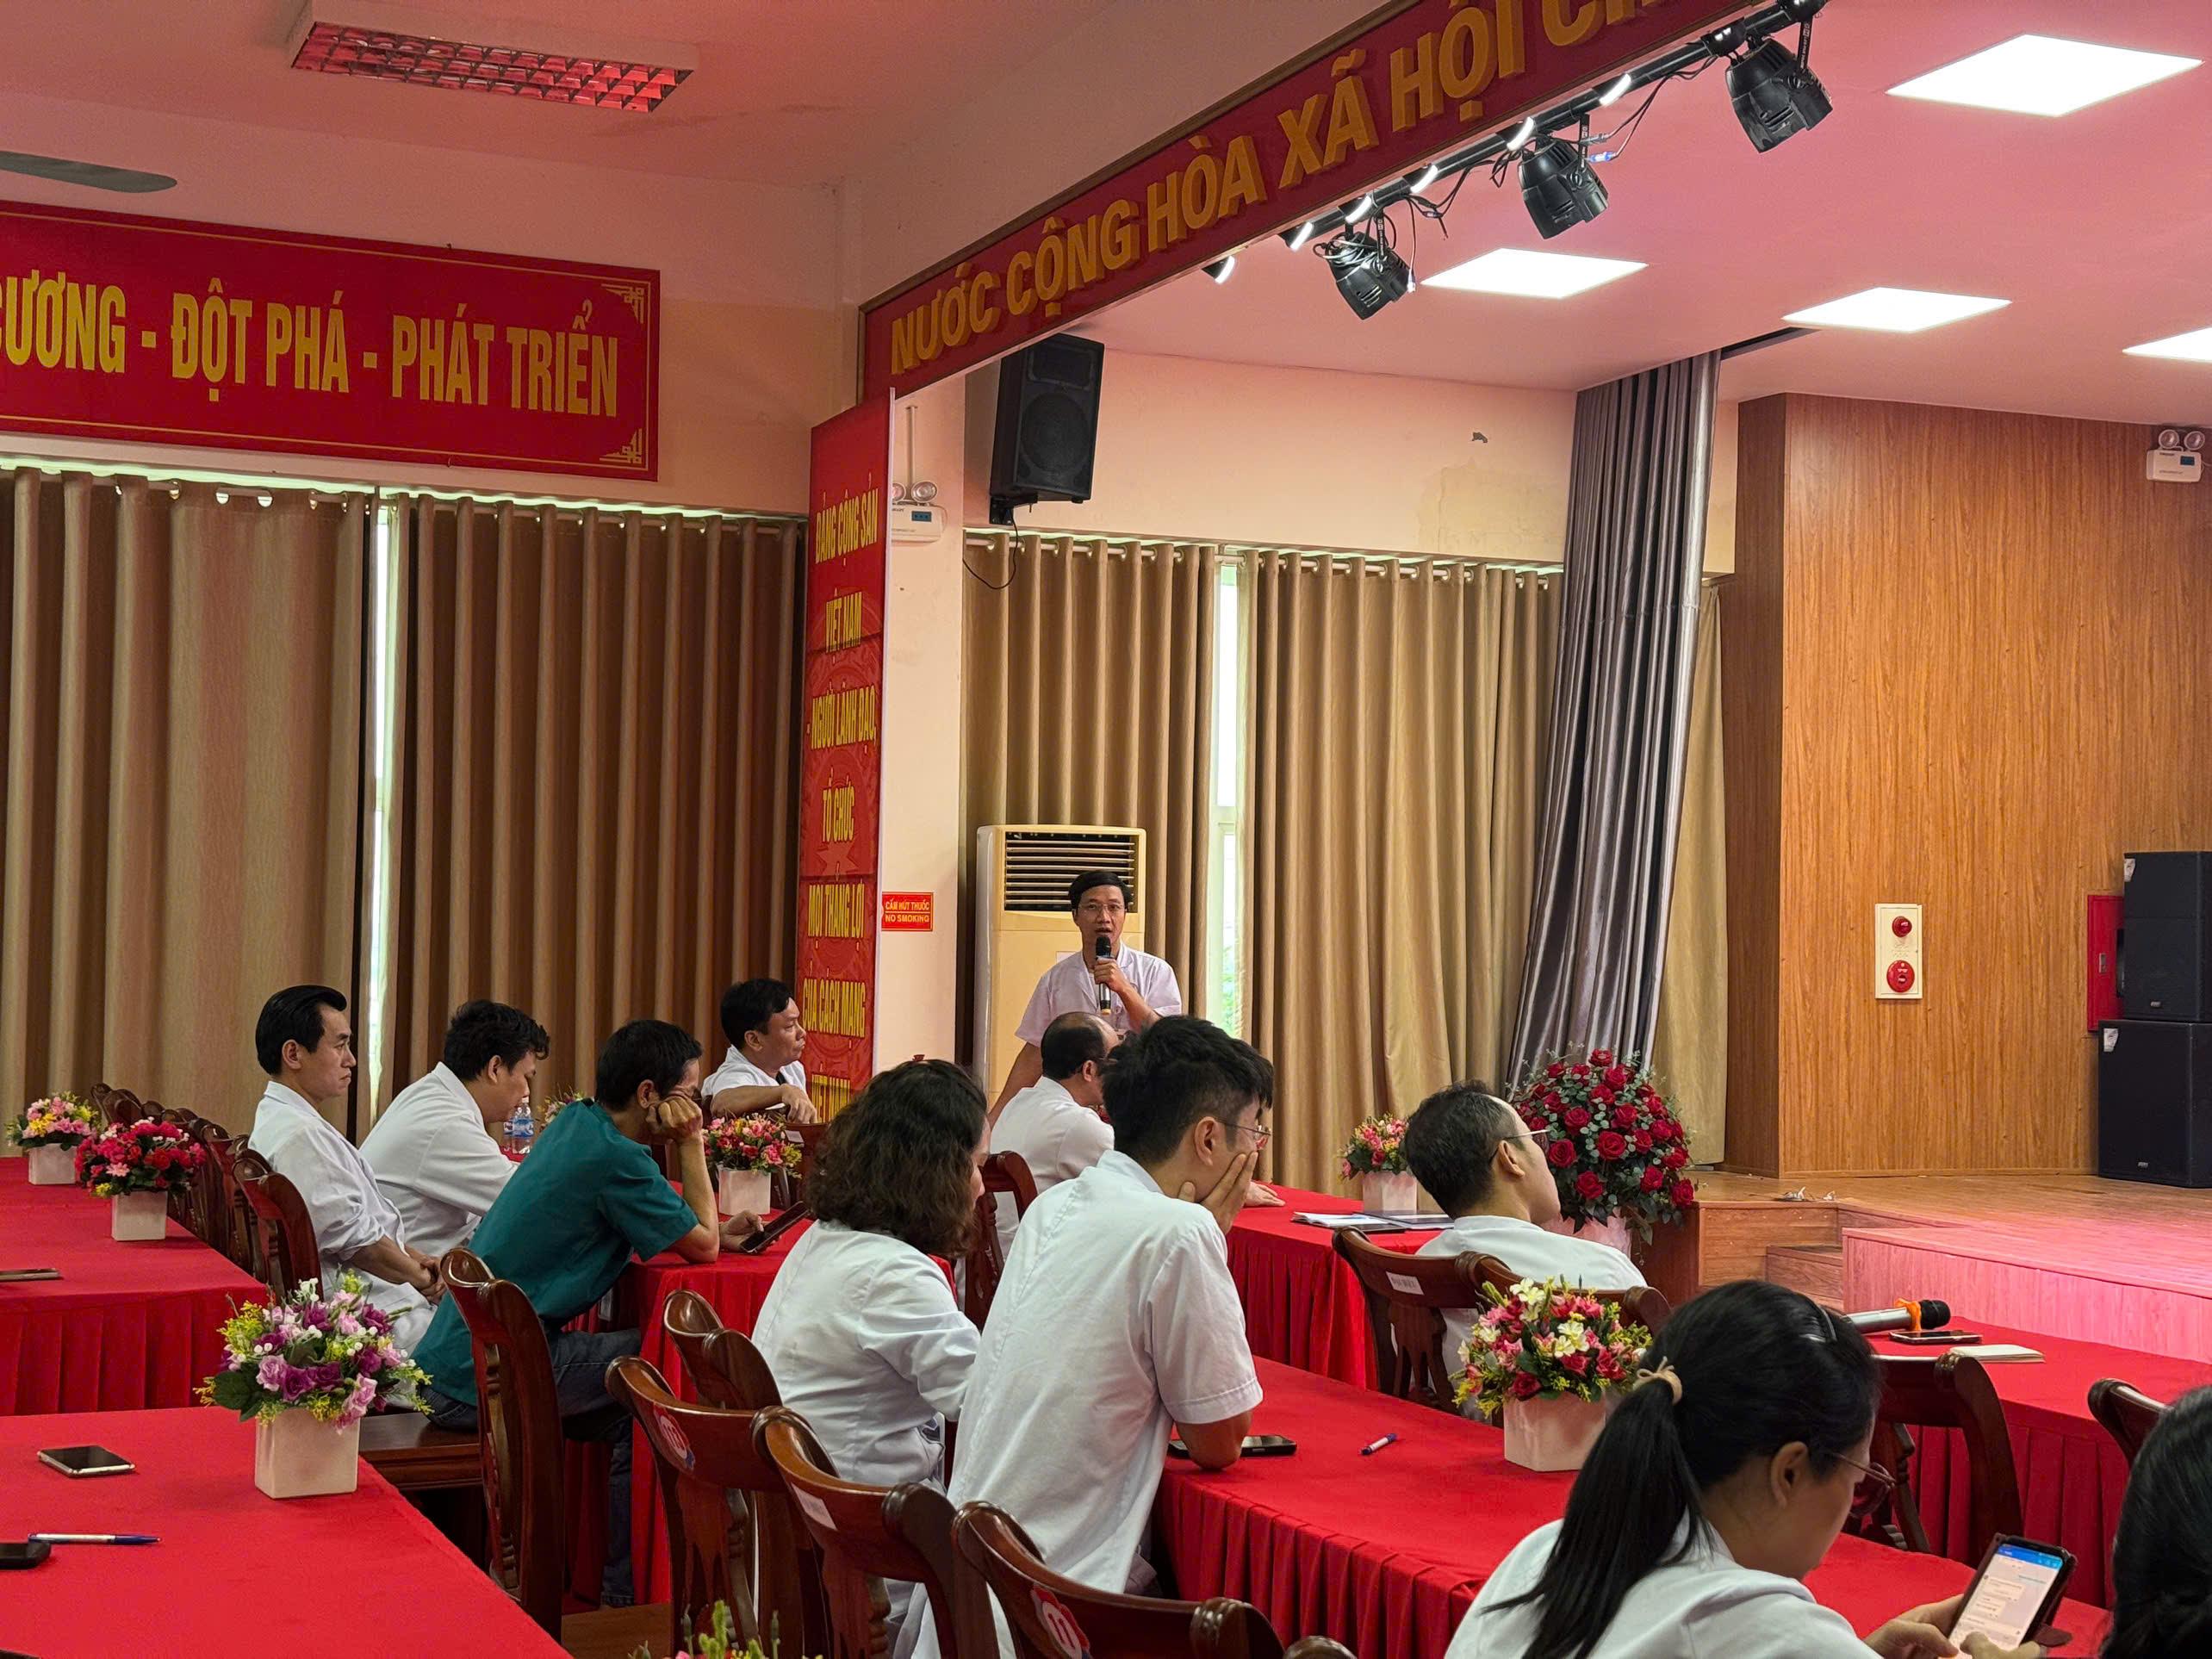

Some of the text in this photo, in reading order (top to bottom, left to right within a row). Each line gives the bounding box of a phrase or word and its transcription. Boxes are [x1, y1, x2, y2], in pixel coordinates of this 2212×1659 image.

[891, 0, 1525, 376] NƯỚC CỘNG HÒA XÃ HỘI
[0, 269, 127, 374] ƯƠNG
[171, 276, 253, 402] ĐỘT
[265, 289, 350, 394] PHÁ
[391, 302, 495, 406] PHÁT
[506, 298, 618, 418] TRIỂN
[815, 471, 879, 566] ĐẢNG CỘNG SẢN
[825, 587, 862, 664] VIỆT NAM
[811, 681, 836, 749] NGƯỜI
[823, 767, 855, 842] TỔ CHỨC
[808, 862, 865, 952] MỌI THẮNG LỢI
[885, 914, 930, 923] NO SMOKING
[803, 960, 866, 1049] CỦA CÁCH MẠNG
